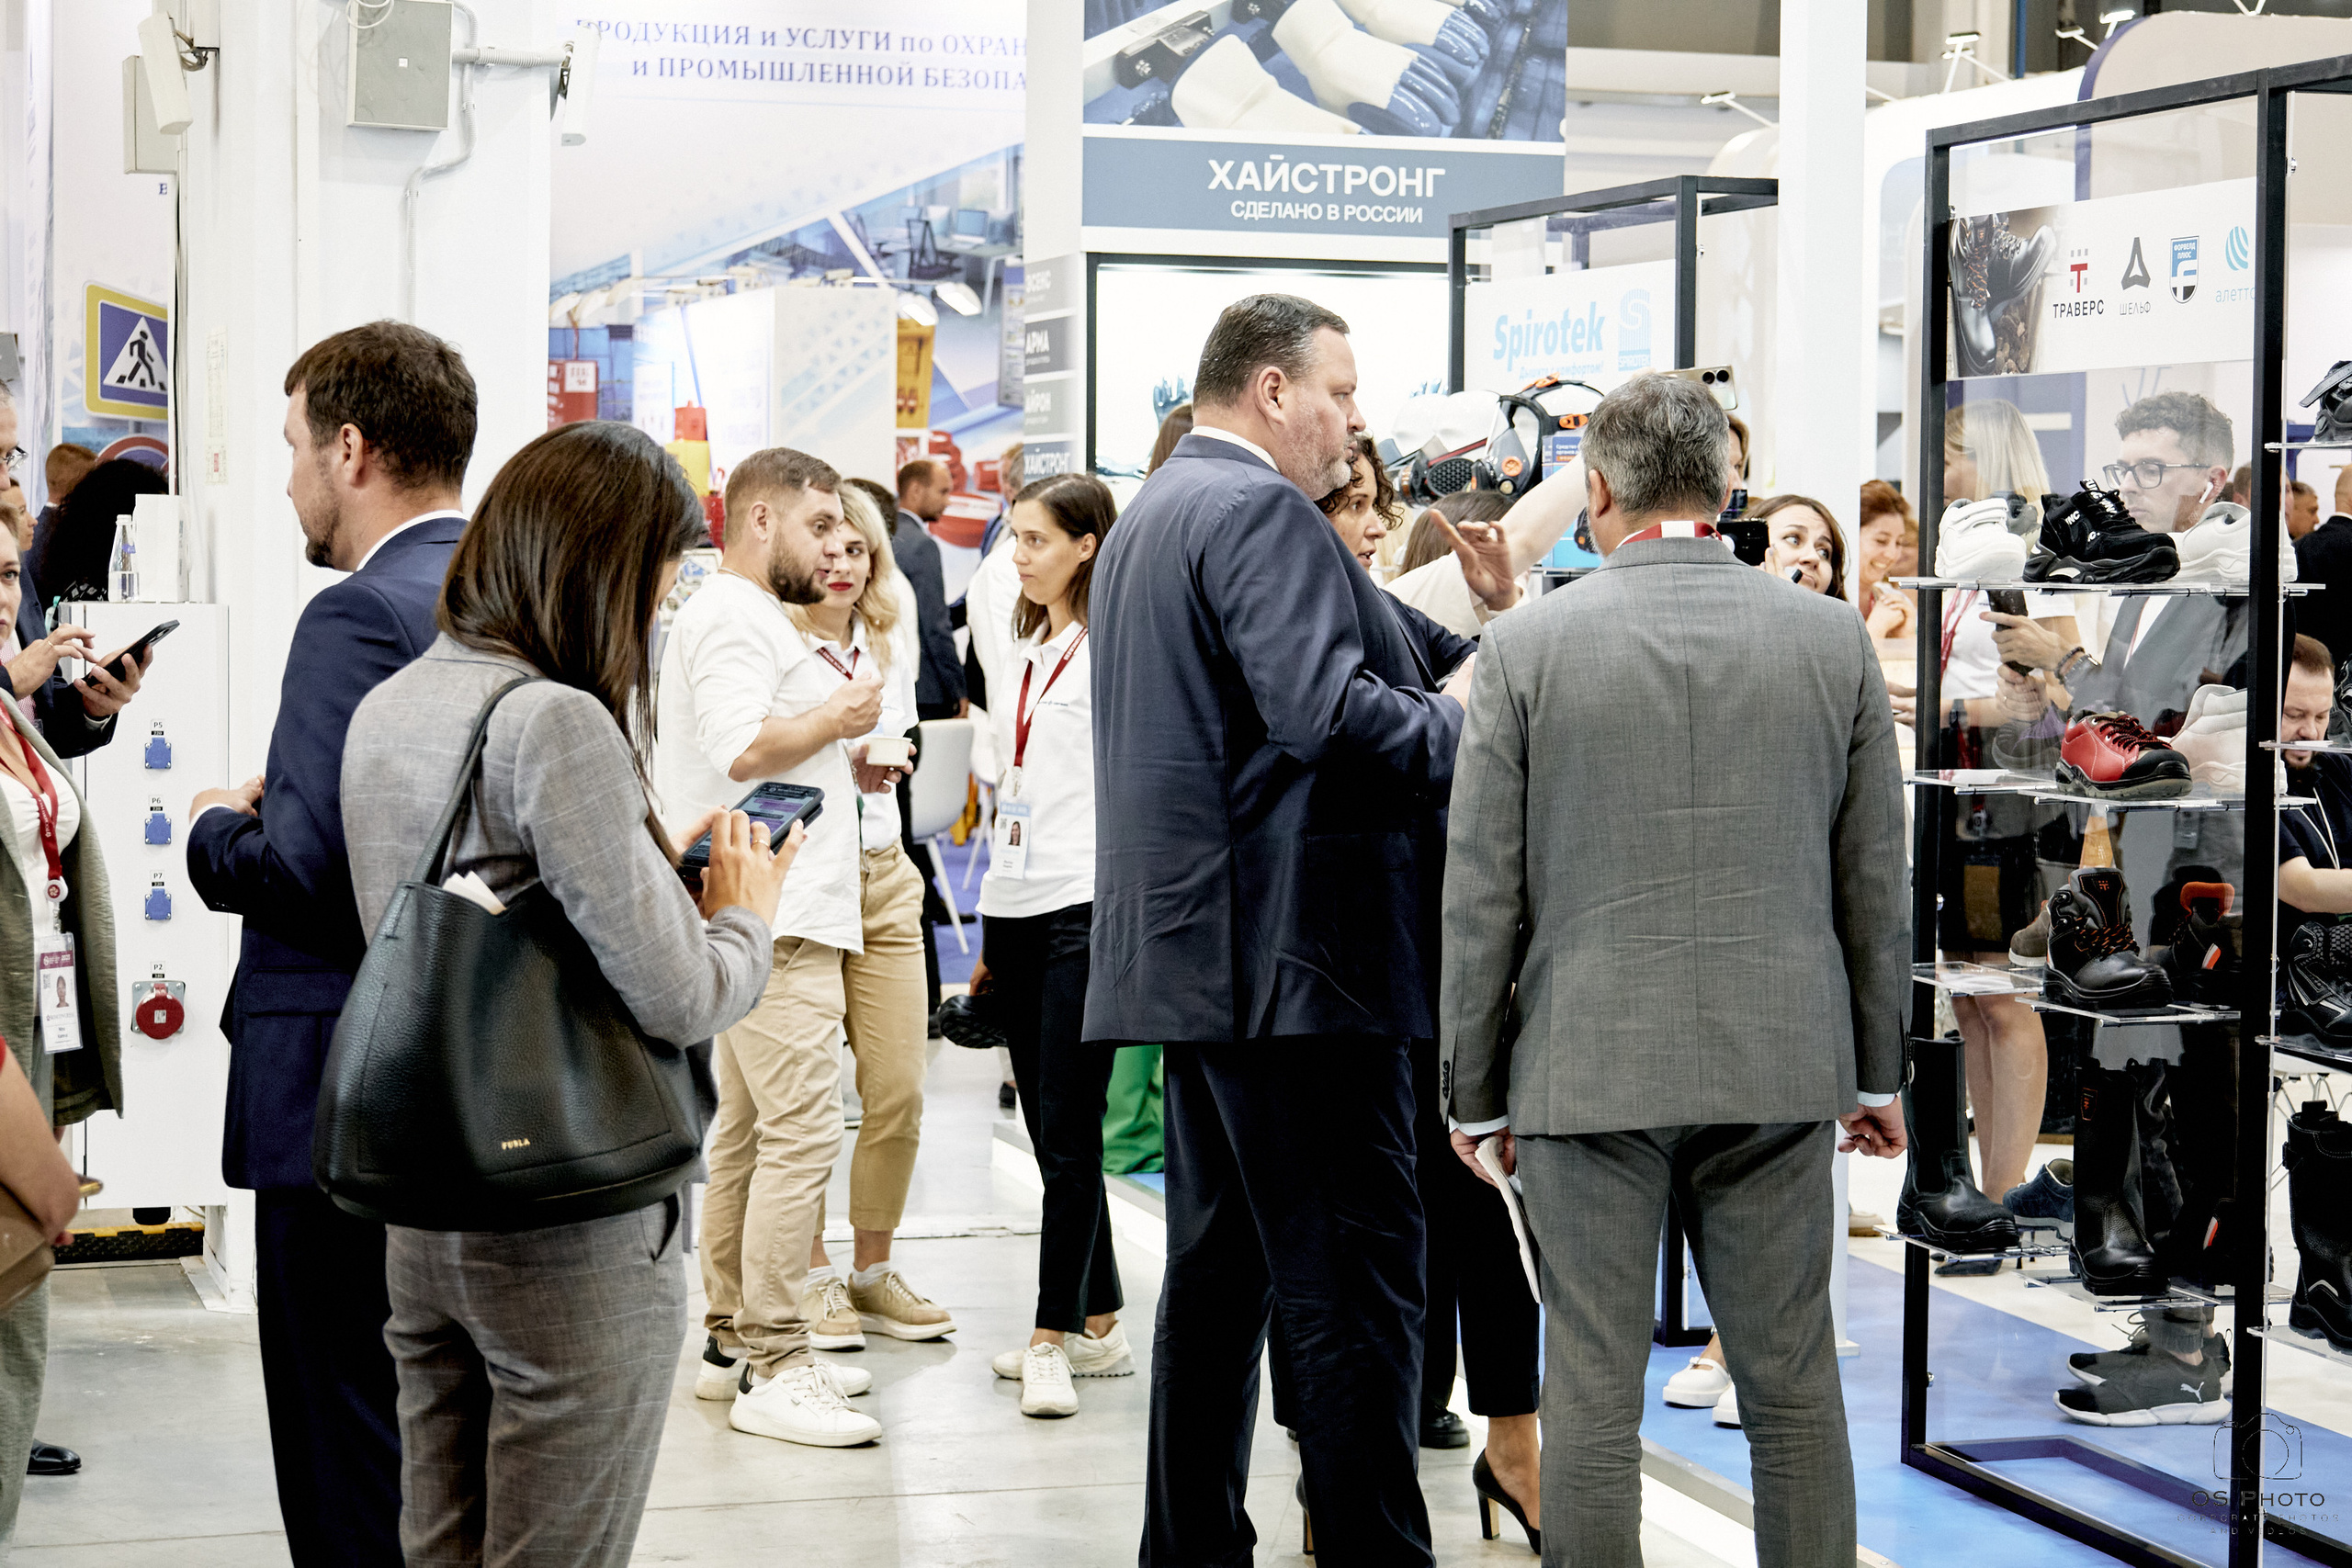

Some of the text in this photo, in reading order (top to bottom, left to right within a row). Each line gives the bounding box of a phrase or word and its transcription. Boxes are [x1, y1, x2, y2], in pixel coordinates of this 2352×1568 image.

[762, 30, 776, 46] и
[787, 28, 891, 51] УСЛУГИ
[901, 37, 933, 52] по
[633, 61, 648, 76] и
[659, 57, 913, 86] ПРОМЫШЛЕННОЙ
[1207, 154, 1446, 197] ХАЙСТРОНГ
[1230, 200, 1423, 223] СДЕЛАНО В РОССИИ
[2052, 299, 2105, 319] ТРАВЕРС
[2119, 301, 2152, 316] ШЕЛЬФ
[1493, 301, 1606, 372] Spirotek
